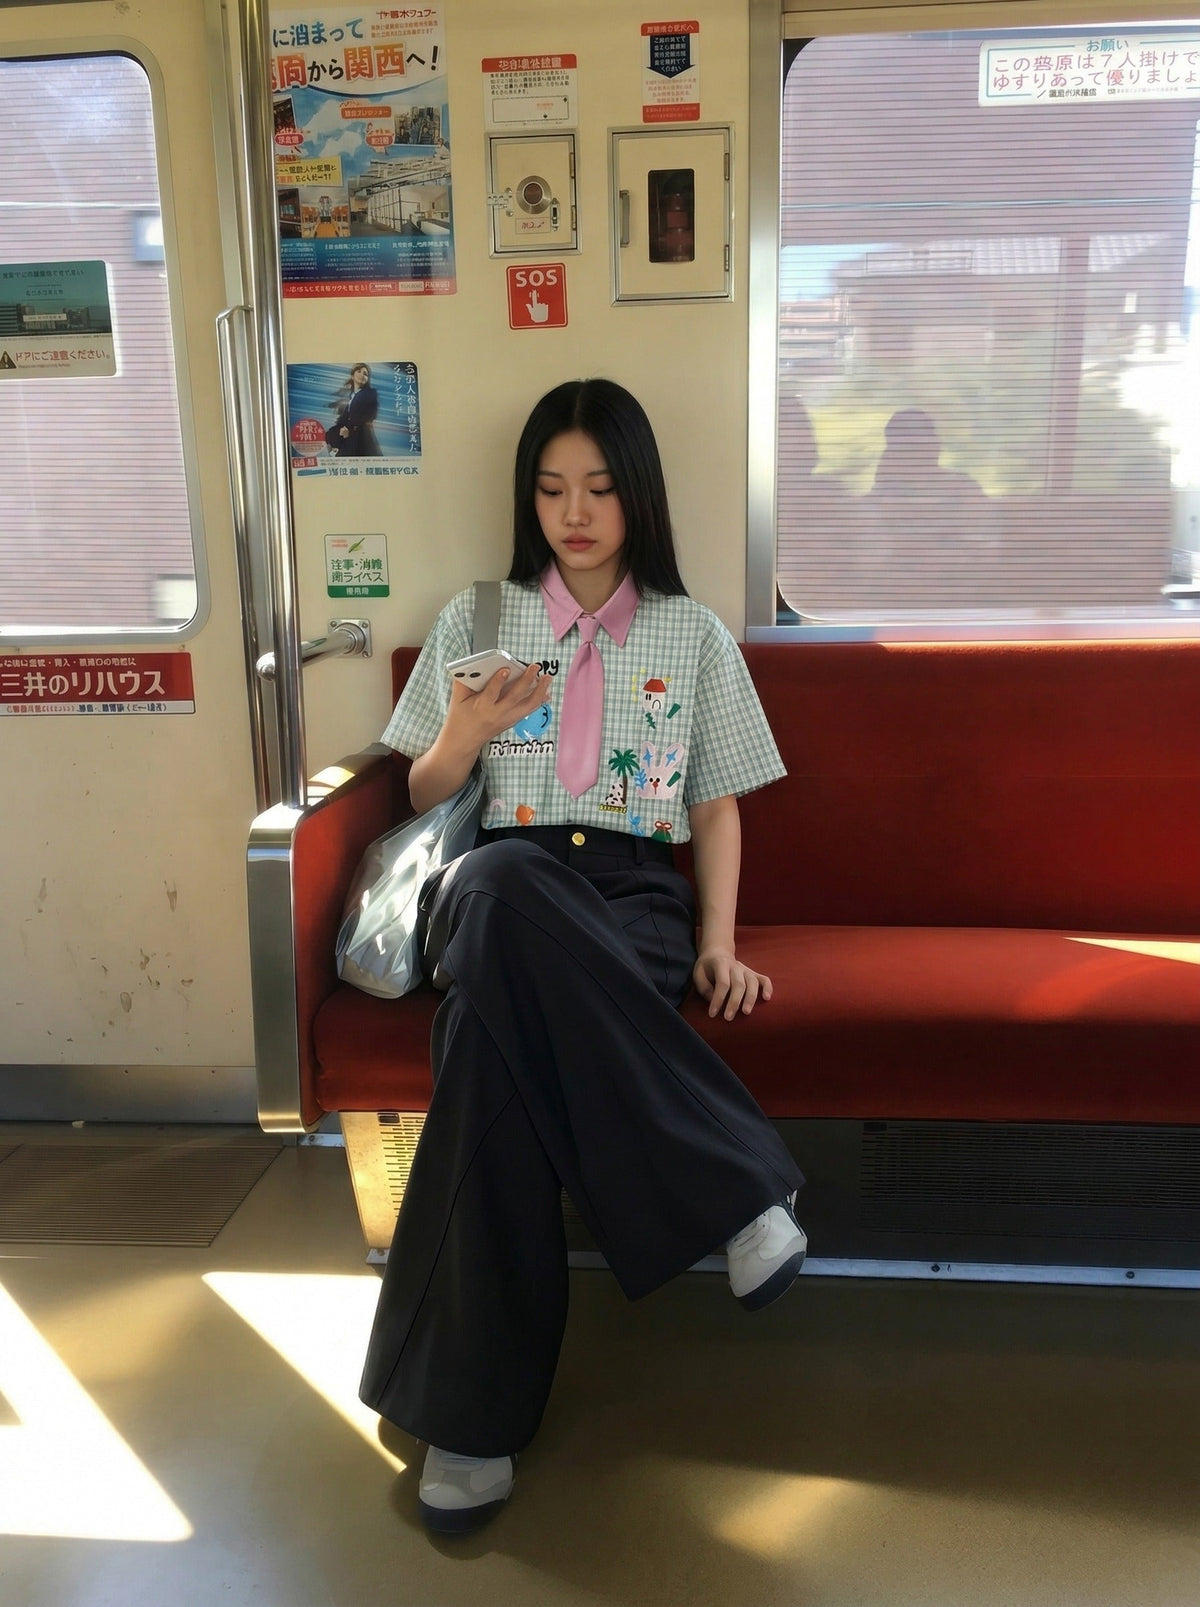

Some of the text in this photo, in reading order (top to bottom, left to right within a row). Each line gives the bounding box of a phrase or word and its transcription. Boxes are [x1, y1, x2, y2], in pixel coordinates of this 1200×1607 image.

[1086, 38, 1130, 52] お願い
[515, 269, 558, 288] SOS
[0, 670, 166, 698] 三井のリハウス
